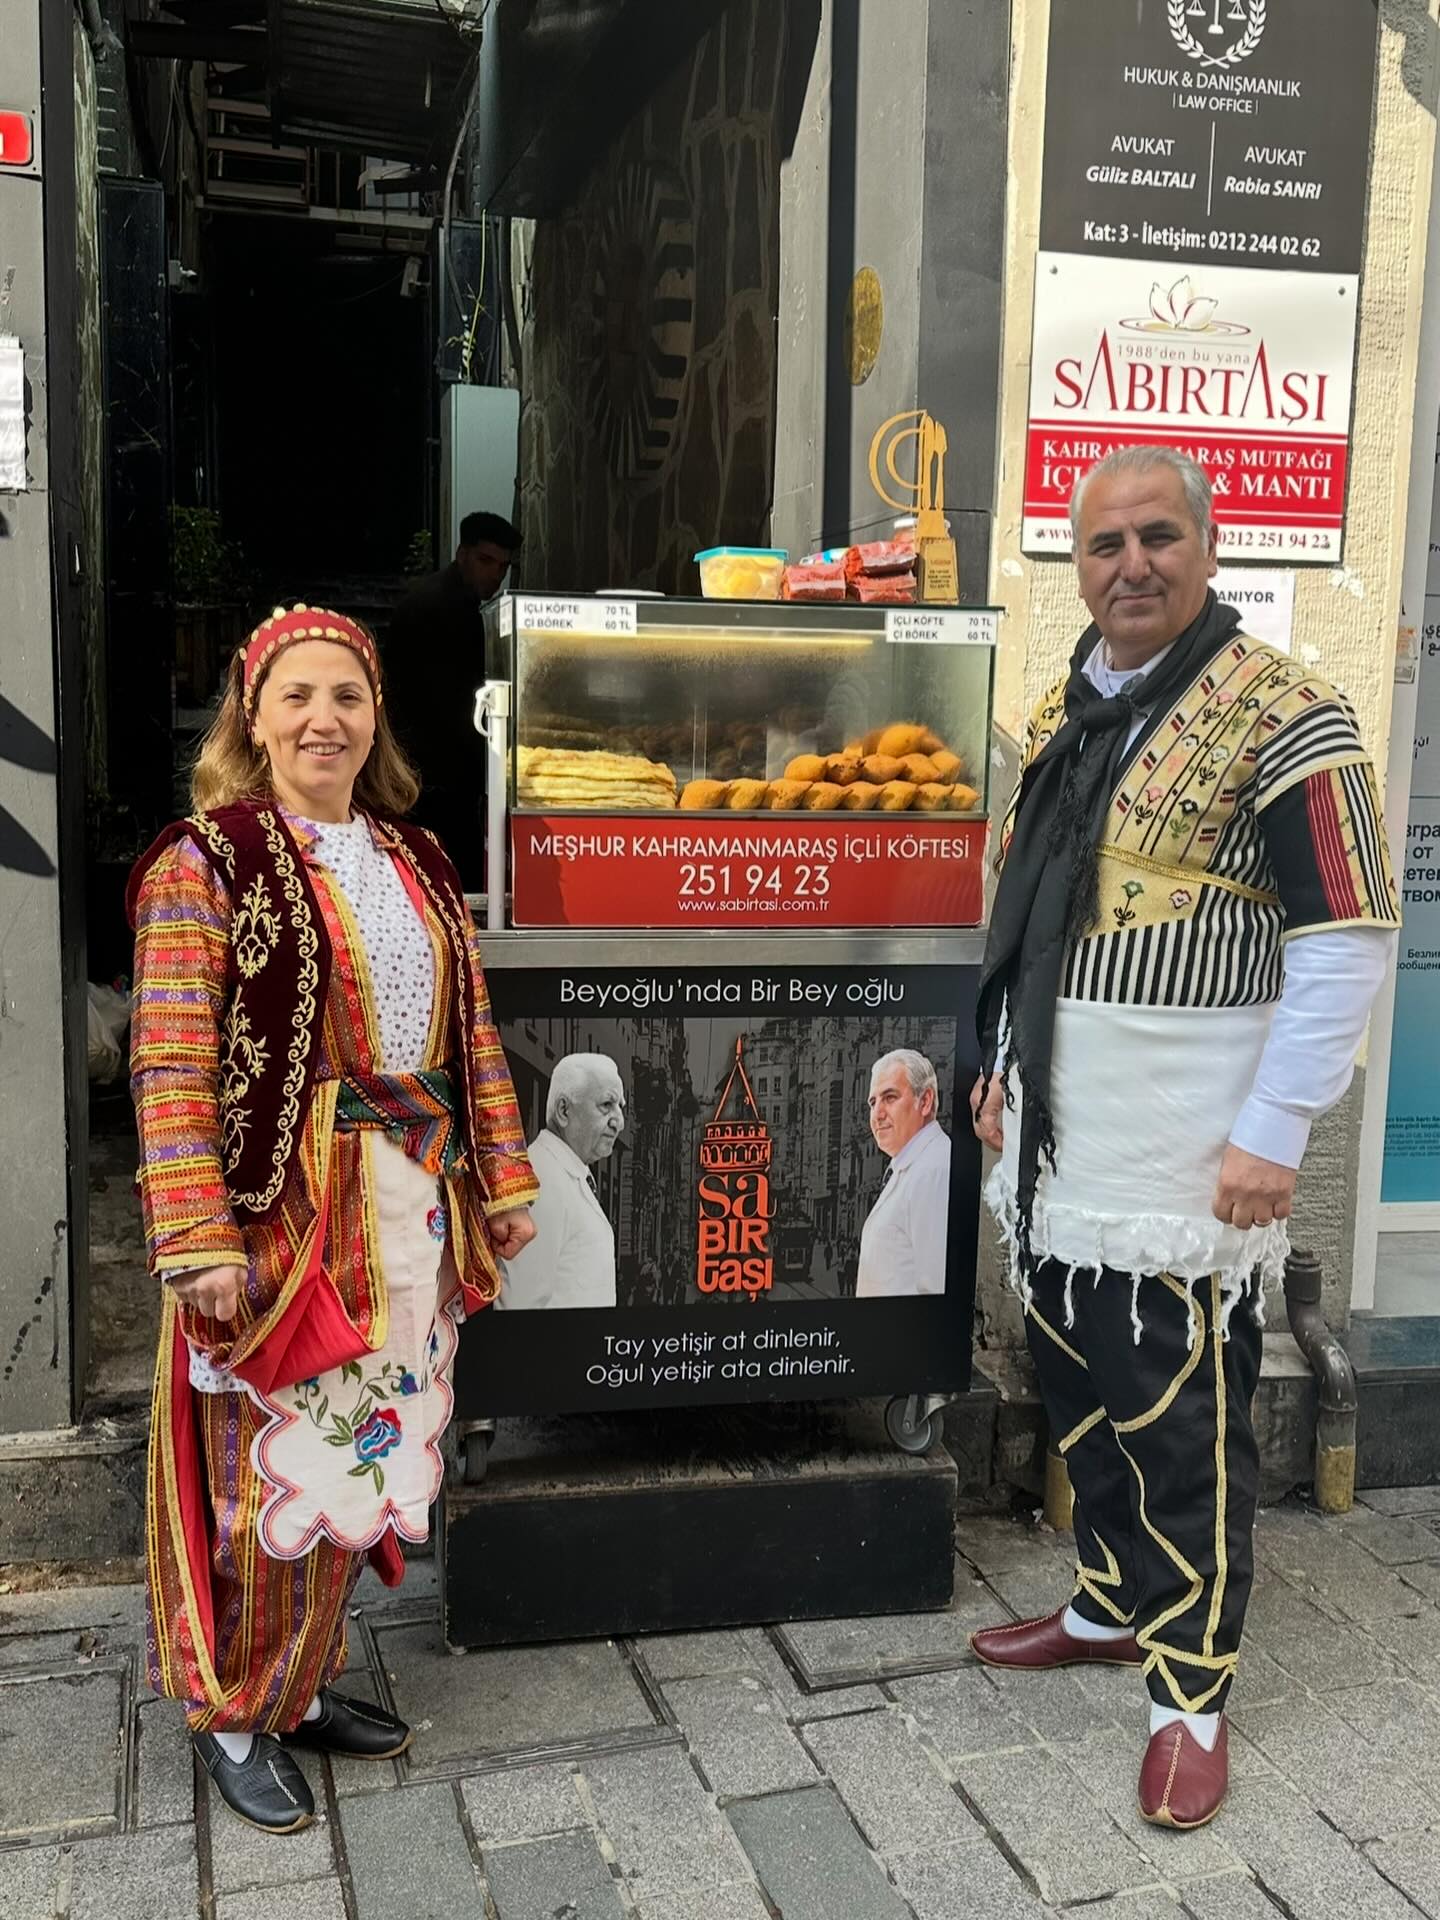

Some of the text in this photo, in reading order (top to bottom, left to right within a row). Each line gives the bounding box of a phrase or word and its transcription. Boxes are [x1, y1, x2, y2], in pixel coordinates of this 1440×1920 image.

[1124, 66, 1301, 97] HUKUK & DANIŞMANLIK
[1178, 94, 1253, 113] LAW OFFICE
[1111, 136, 1175, 156] AVUKAT
[1244, 146, 1306, 167] AVUKAT
[1086, 165, 1196, 189] Güliz BALTALI
[1224, 176, 1322, 200] Rabia SANRI
[1084, 221, 1116, 242] Kat:
[1119, 224, 1129, 243] 3
[1142, 221, 1206, 251] İletişim:
[1209, 231, 1246, 251] 0212
[1249, 234, 1277, 254] 244
[1281, 236, 1299, 255] 02
[1302, 238, 1321, 257] 62
[1193, 348, 1210, 362] bu
[1217, 353, 1251, 365] yana
[1054, 327, 1328, 426] SABIRTAŞI
[1240, 449, 1332, 470] MUTFAĞI
[1211, 472, 1232, 495] &
[1240, 473, 1331, 499] MANTI
[1258, 532, 1283, 547] 251
[1289, 533, 1308, 548] 94
[546, 602, 580, 614] KÖFTE
[605, 606, 616, 615] 70
[620, 606, 631, 615] TL
[914, 614, 945, 627] KÖFTE
[968, 617, 979, 627] 70
[982, 618, 992, 627] TL
[538, 616, 573, 629] BÖREK
[605, 621, 616, 630] 60
[620, 621, 631, 630] TL
[905, 628, 938, 640] BÖREK
[968, 632, 978, 641] 60
[981, 632, 991, 641] TL
[530, 833, 970, 863] MEŞHUR KAHRAMANMARAŞ İÇLİ KÖFTESİ
[678, 864, 830, 895] 251 94 23
[560, 978, 905, 1008] Beyoğlu'nda Bir Bey oğlu
[697, 1219, 769, 1254] BIR
[604, 1327, 840, 1359] Tay yetişir at dinlenir,
[586, 1354, 856, 1388] Oğul yetişir ata dinlenir.
